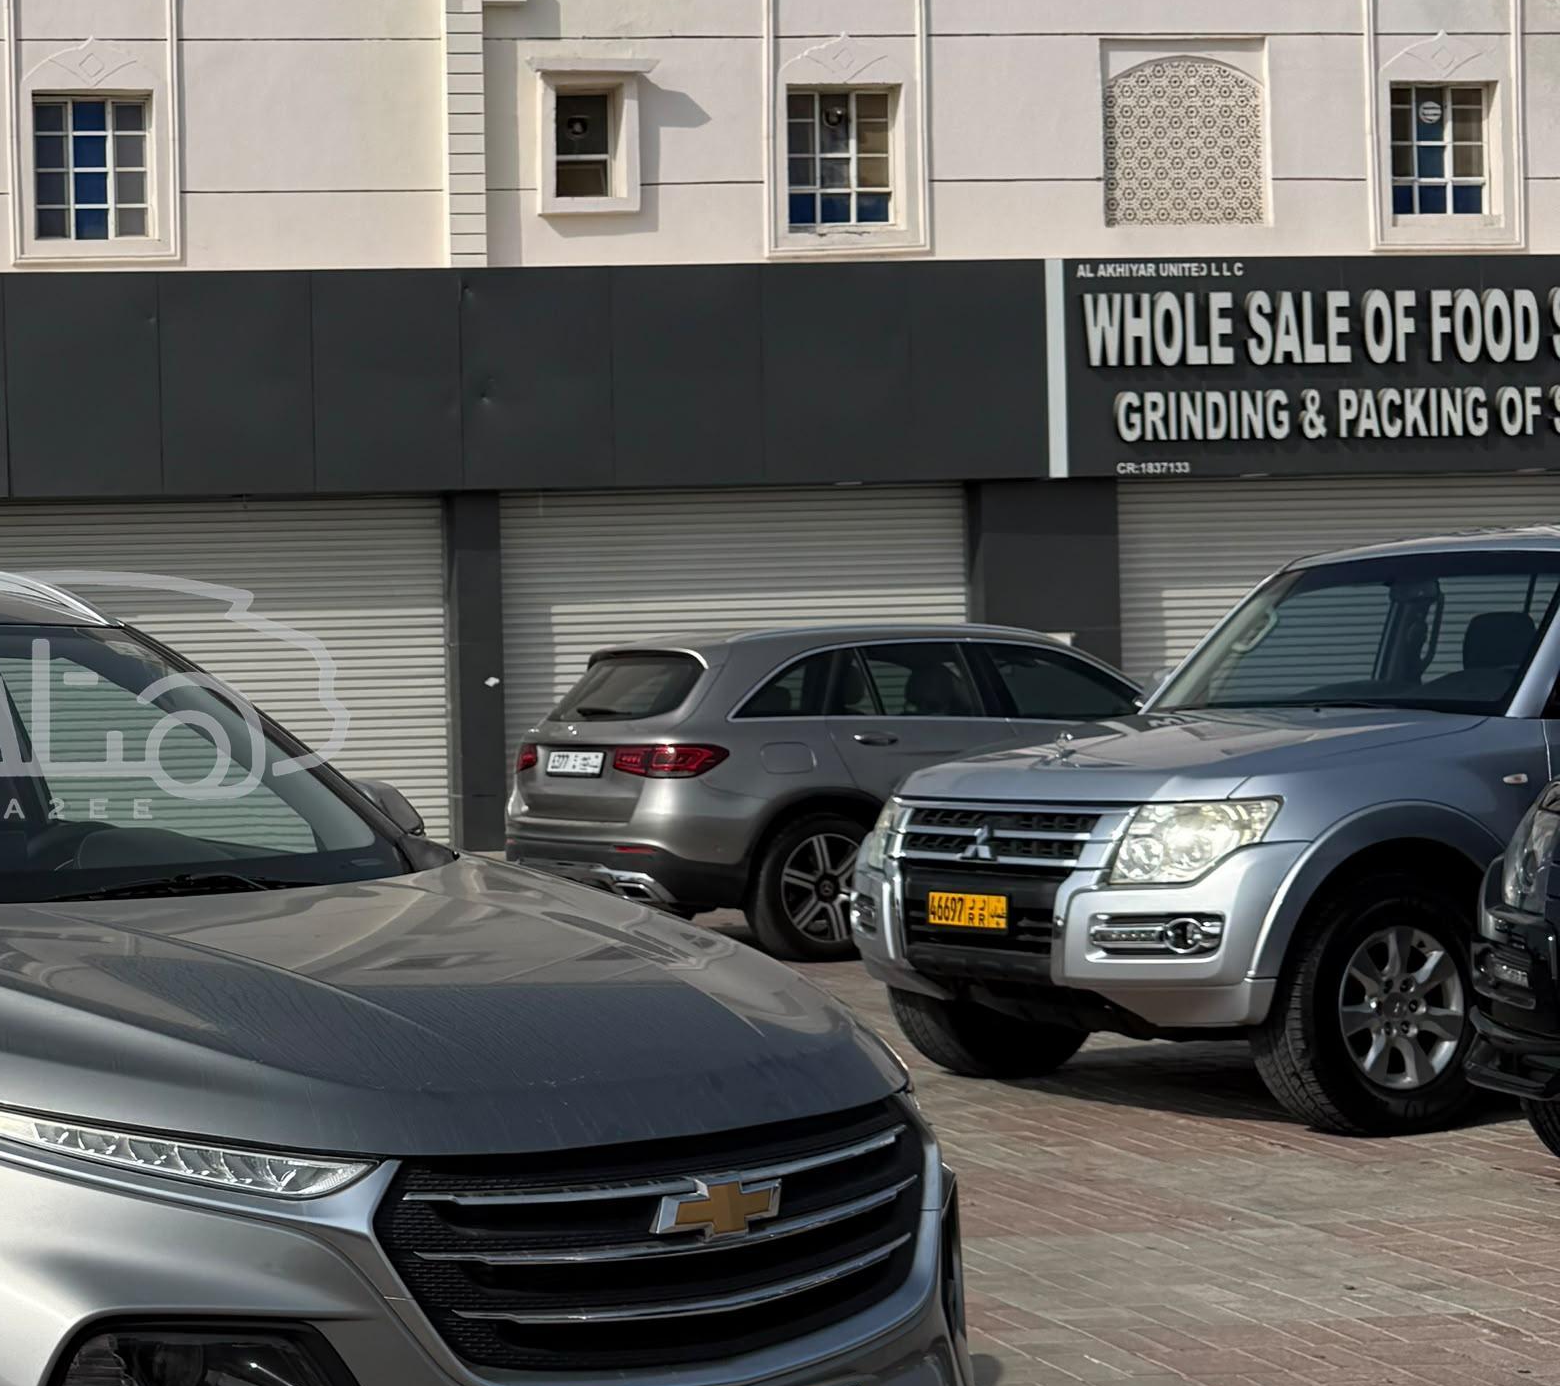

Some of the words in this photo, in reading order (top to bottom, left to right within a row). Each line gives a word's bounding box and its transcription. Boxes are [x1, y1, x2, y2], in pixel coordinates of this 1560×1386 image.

[1076, 263, 1095, 278] AL
[1097, 263, 1156, 278] AKHIYAR
[1083, 291, 1235, 367] WHOLE
[1245, 289, 1352, 366] SALE
[1362, 288, 1417, 364] OF
[1430, 288, 1540, 363] FOOD
[1114, 388, 1290, 443] GRINDING
[1301, 387, 1327, 440] &
[1339, 386, 1489, 438] PACKING
[1496, 386, 1542, 436] OF
[929, 895, 964, 923] 46697
